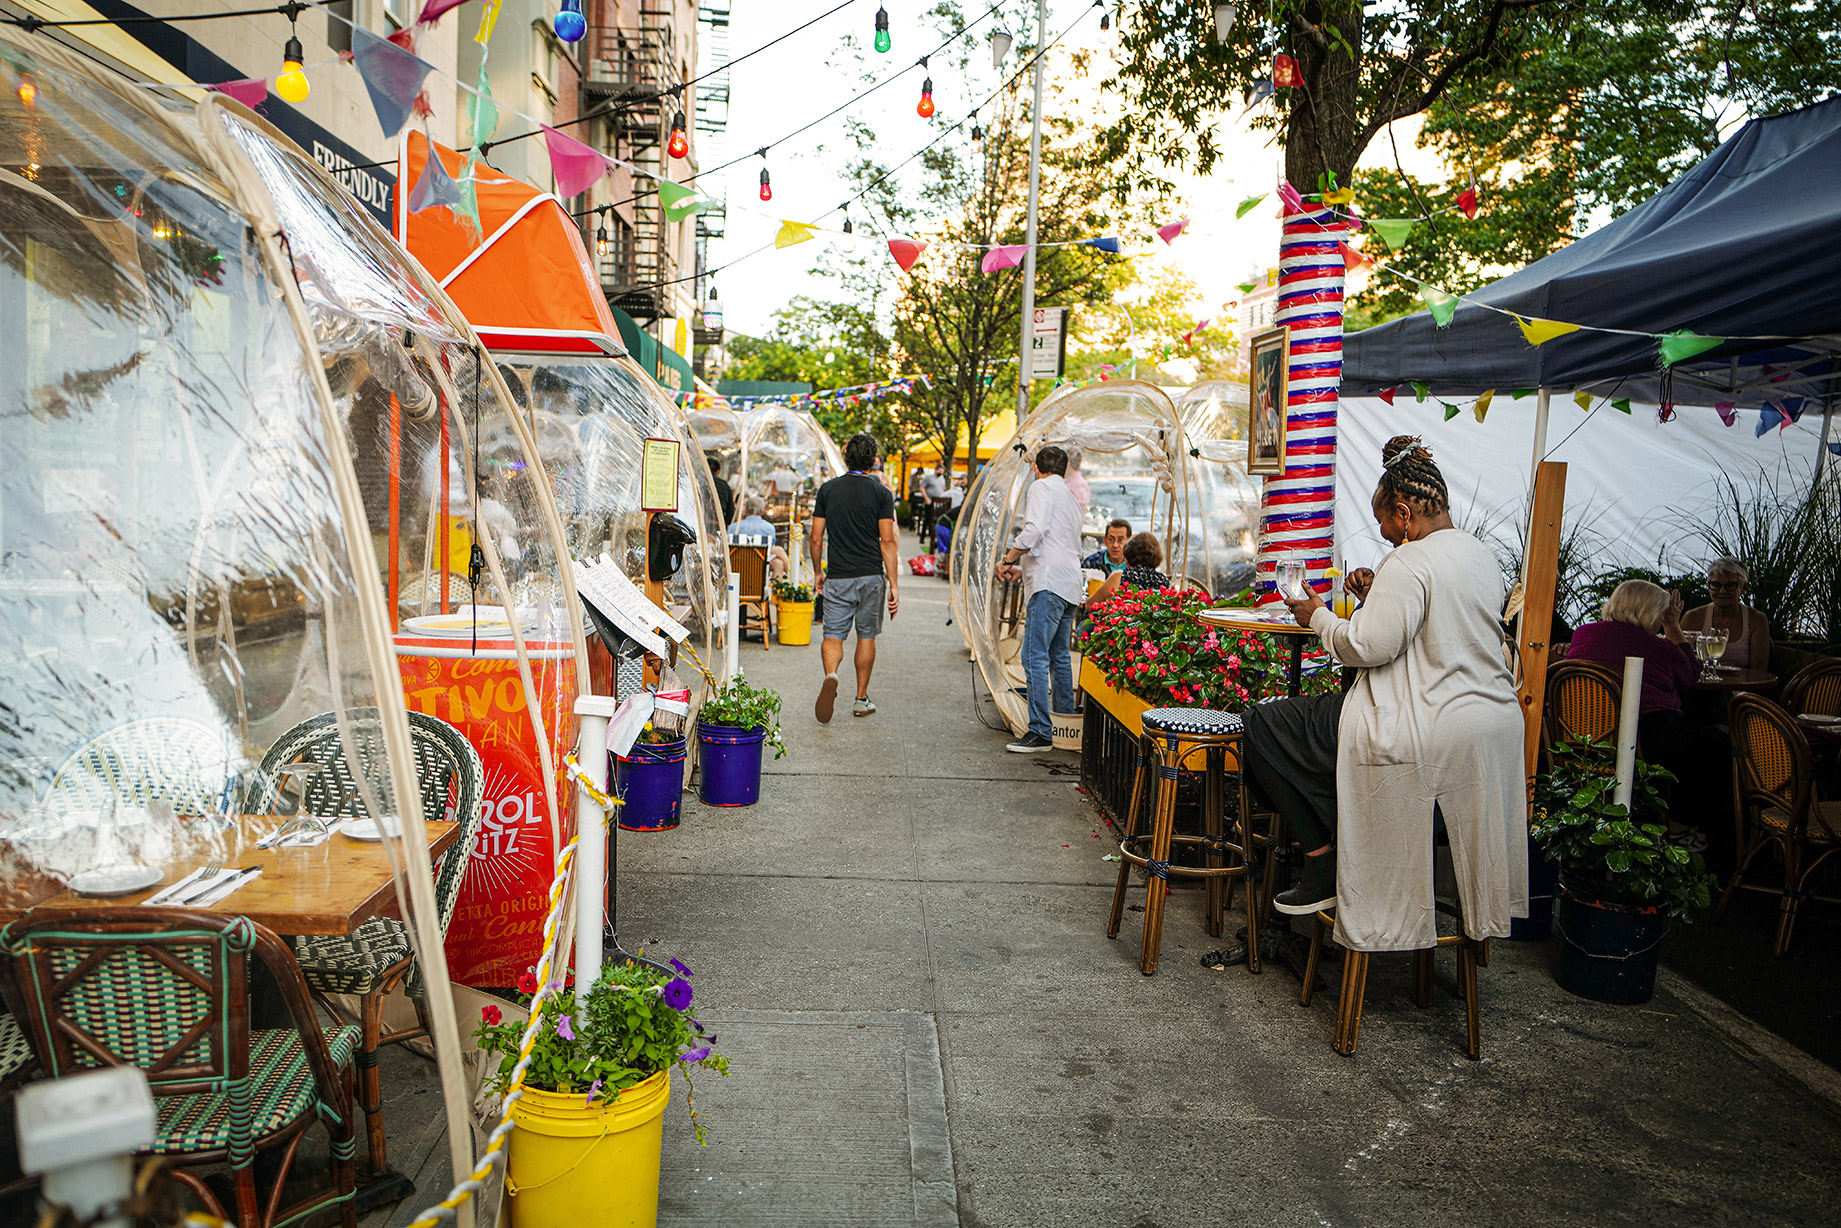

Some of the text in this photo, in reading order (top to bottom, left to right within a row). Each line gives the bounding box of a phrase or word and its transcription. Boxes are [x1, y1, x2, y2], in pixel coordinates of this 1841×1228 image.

[313, 140, 389, 212] FRIENDLY
[404, 677, 528, 722] TIVO
[1053, 726, 1080, 738] antor
[455, 895, 552, 921] ETTA ORIGIN
